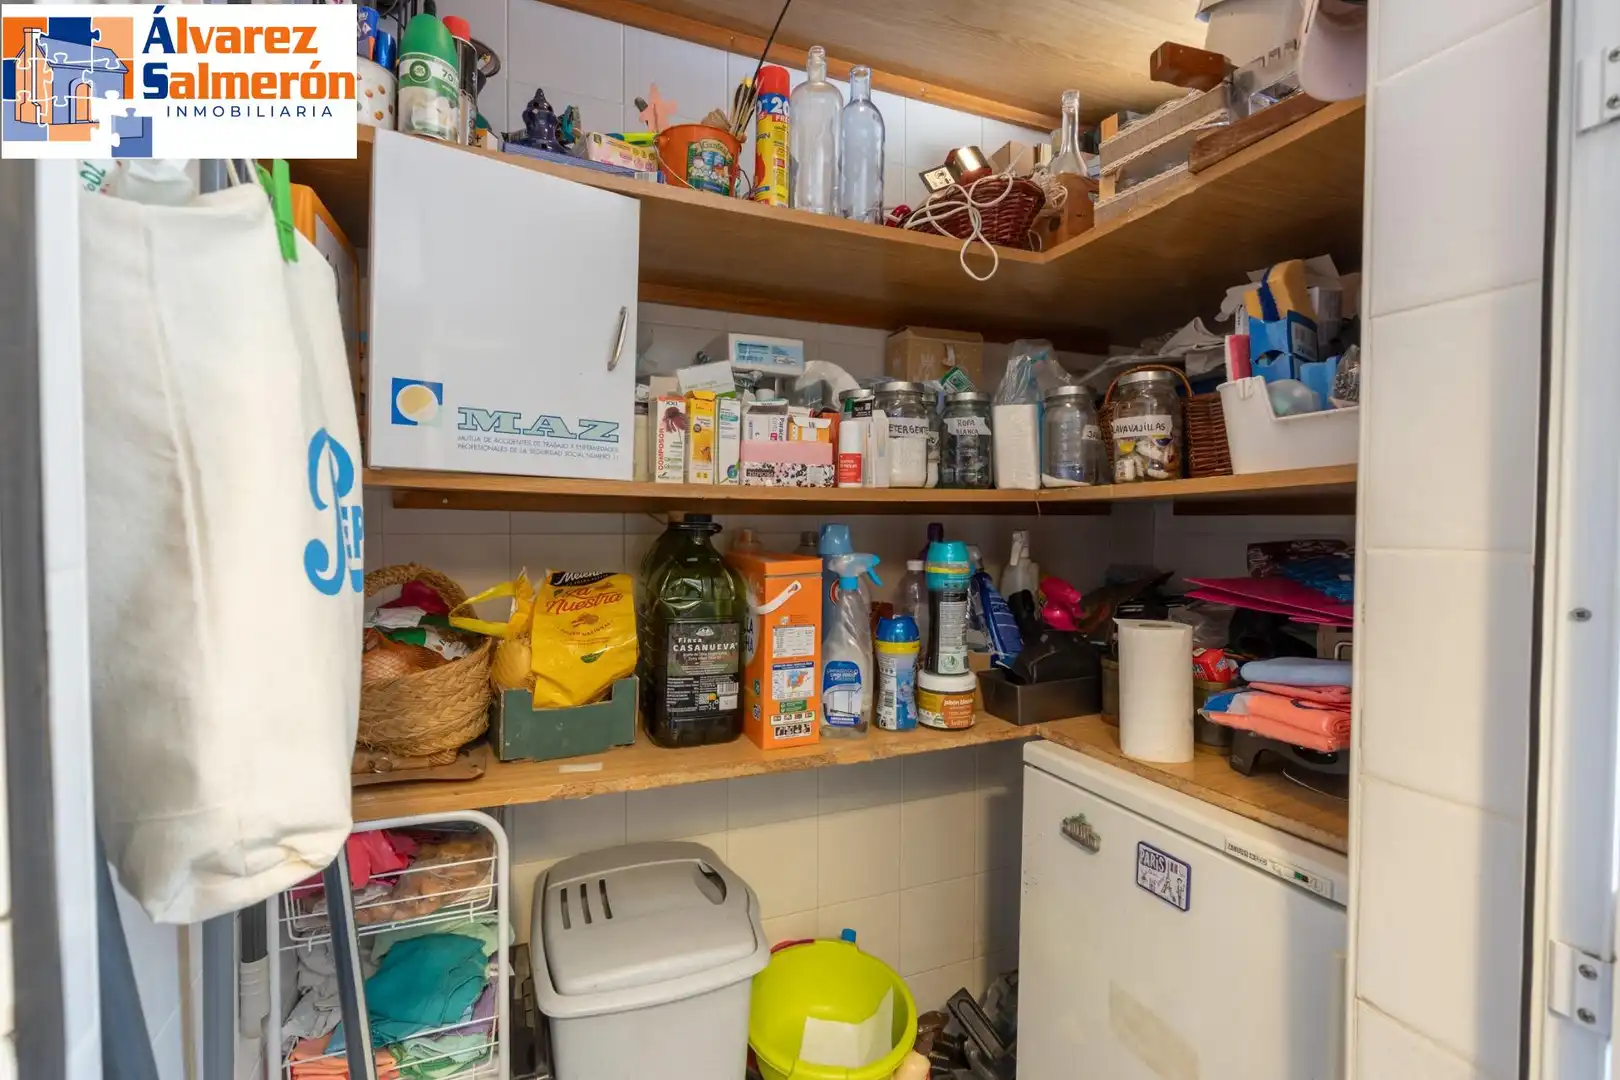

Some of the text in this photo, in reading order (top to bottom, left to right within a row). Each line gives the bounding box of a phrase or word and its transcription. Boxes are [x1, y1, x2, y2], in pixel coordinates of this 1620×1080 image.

[457, 407, 619, 443] MAZ
[546, 591, 623, 615] Nuestra
[673, 643, 737, 652] CASANUEVA
